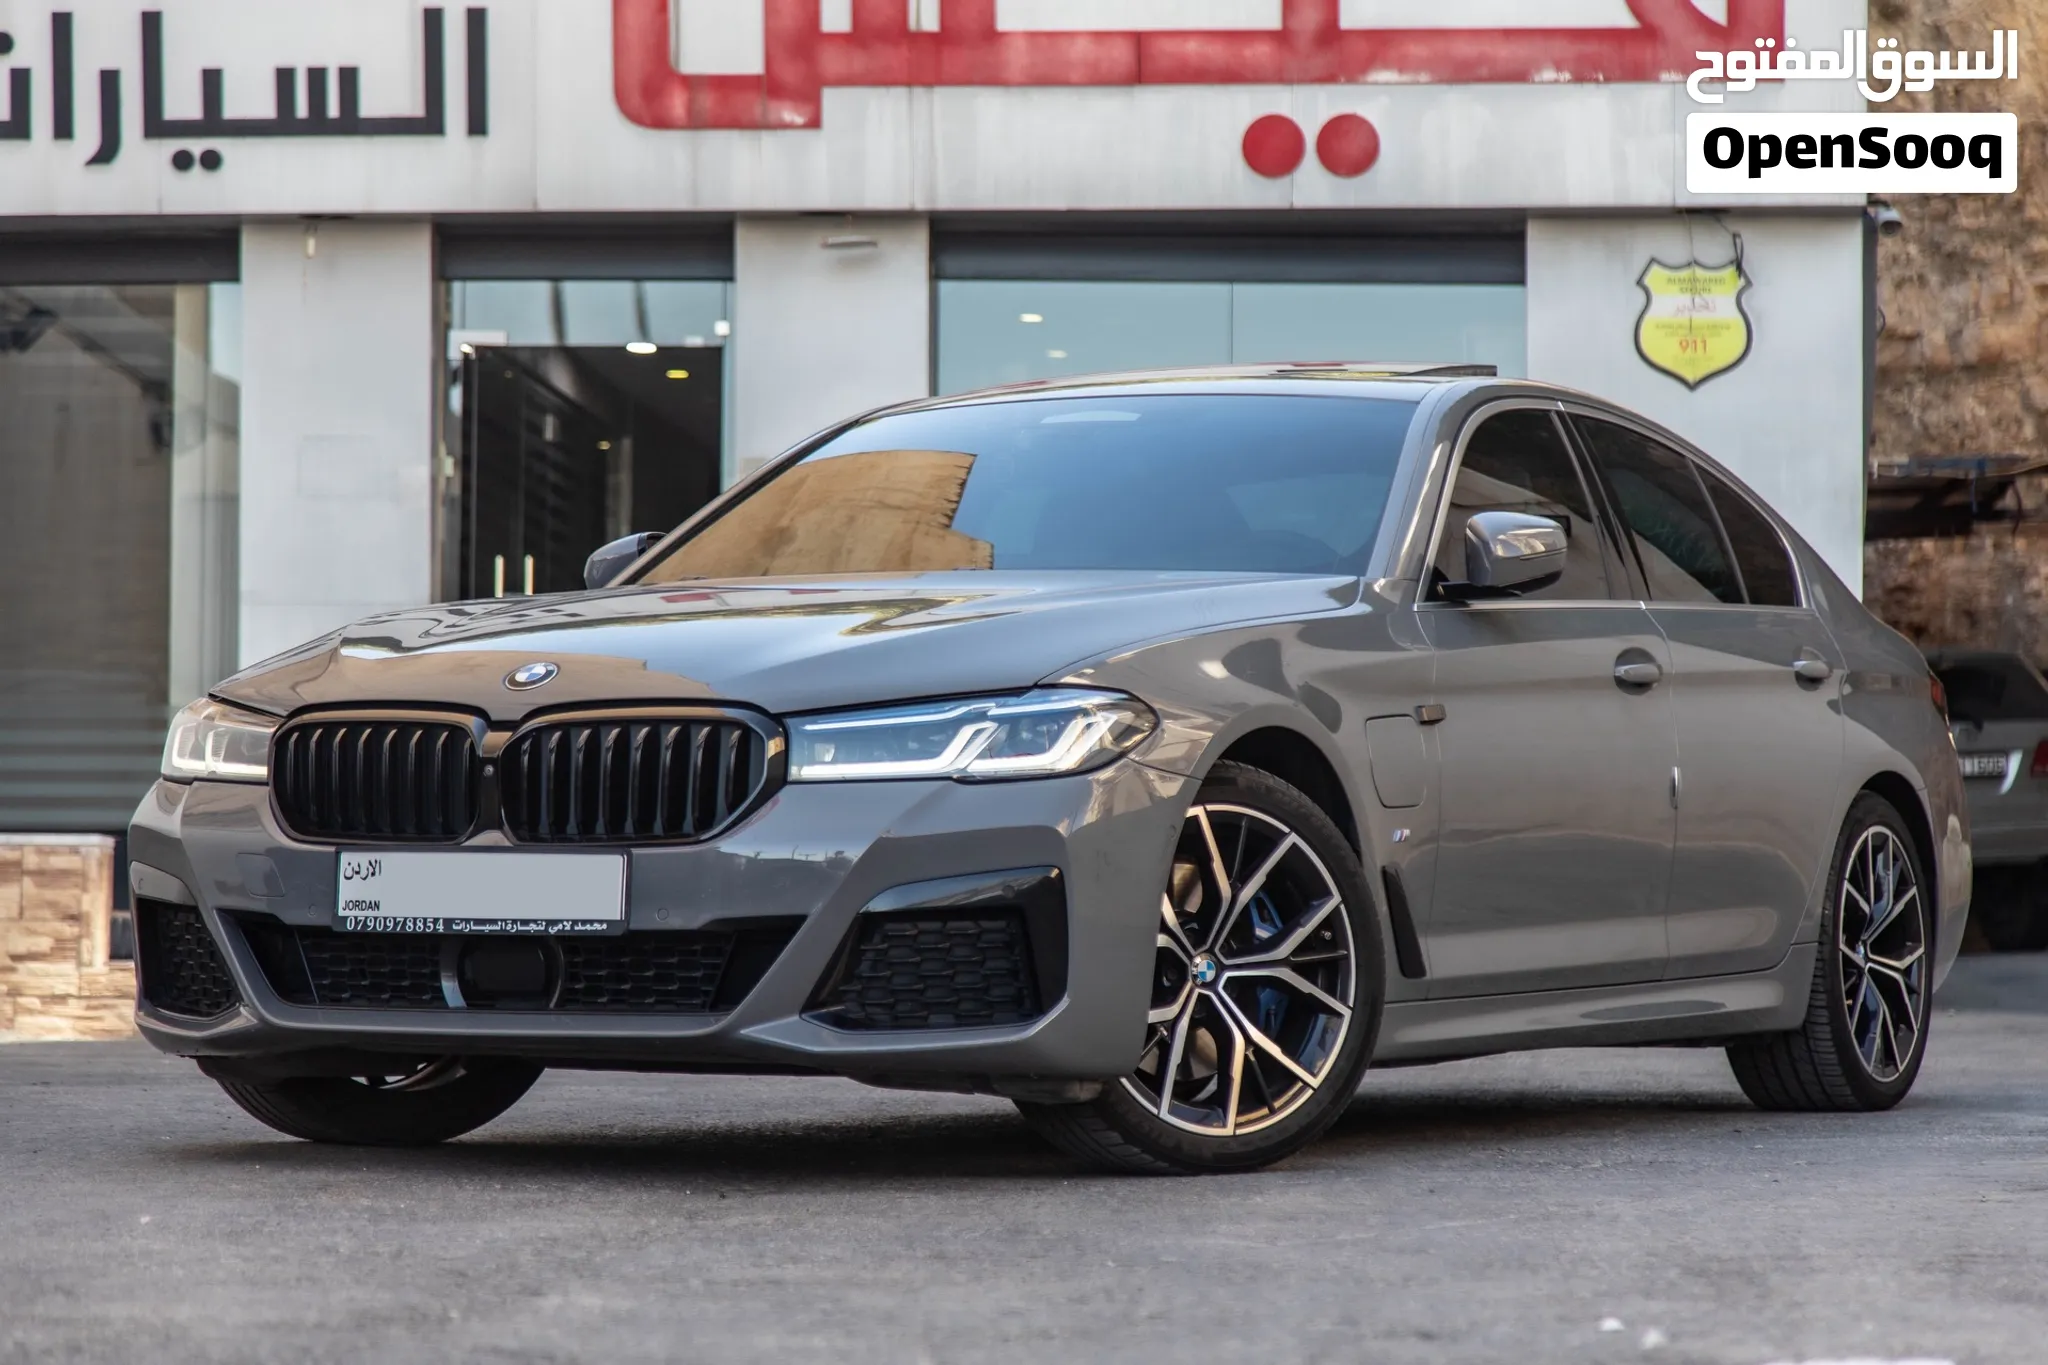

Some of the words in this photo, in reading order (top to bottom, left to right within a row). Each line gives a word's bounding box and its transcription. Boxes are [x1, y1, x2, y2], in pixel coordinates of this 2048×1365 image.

[1679, 338, 1708, 354] 911
[343, 858, 382, 881] الاردن
[342, 899, 380, 912] JORDAN
[346, 916, 445, 932] 0790978854
[452, 920, 505, 932] السيارات
[505, 920, 547, 933] لتجارة
[574, 920, 608, 931] محمد
